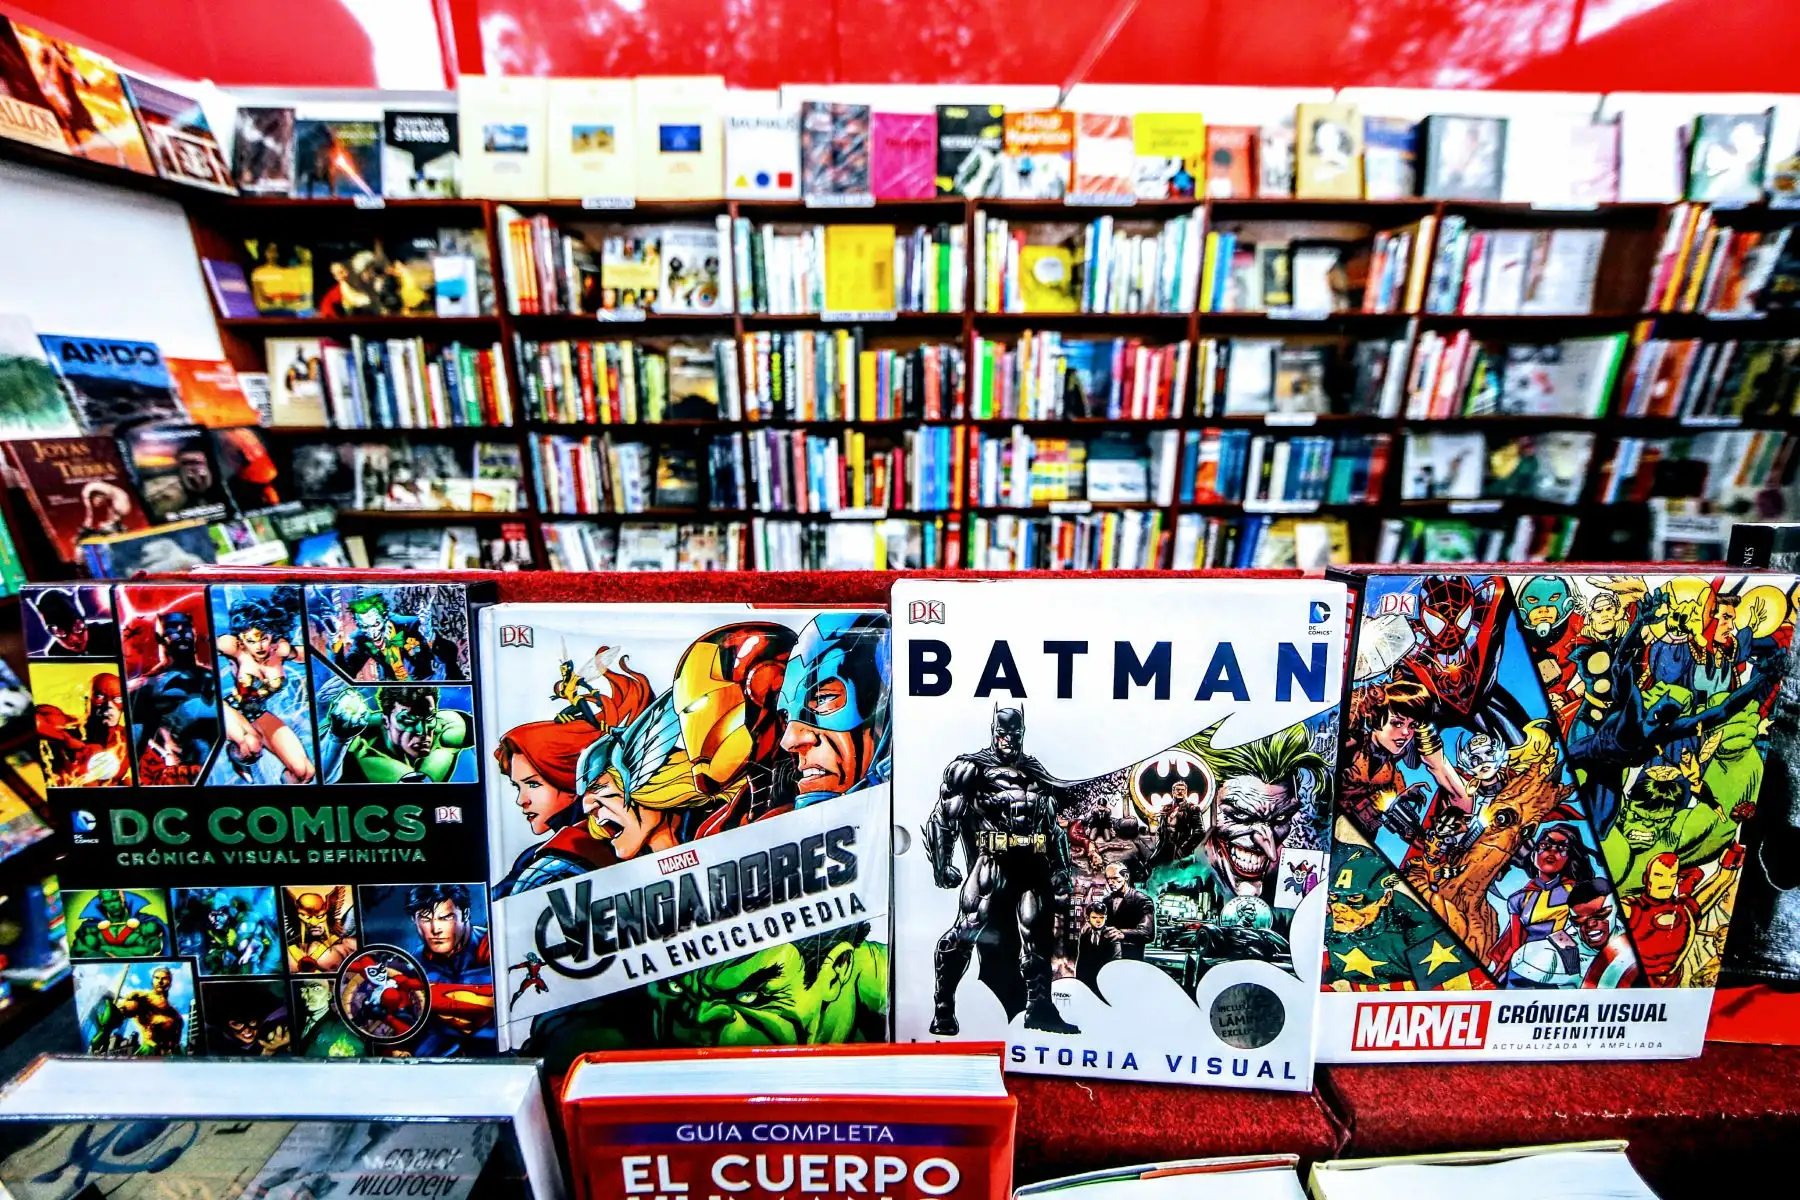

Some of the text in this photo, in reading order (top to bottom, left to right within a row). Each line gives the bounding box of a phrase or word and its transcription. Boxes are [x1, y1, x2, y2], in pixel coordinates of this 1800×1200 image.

[62, 342, 160, 367] ANDO
[911, 601, 942, 621] DK
[1383, 595, 1413, 613] DK
[502, 626, 531, 645] DK
[908, 639, 1329, 702] BATMAN
[109, 804, 426, 845] DC COMICS
[437, 806, 460, 821] DK
[116, 849, 427, 867] CRÓNICA VISUAL DEFINITIVA
[659, 851, 698, 874] MARVEL
[536, 825, 857, 979] VENGADORES
[622, 892, 868, 980] LA ENCICLOPEDIA
[1497, 1000, 1668, 1024] CRÓNICA VISUAL
[1356, 1004, 1484, 1049] MARVEL
[1532, 1026, 1626, 1040] DEFINITIVA
[1599, 1041, 1664, 1049] AMPLIADA
[1011, 1045, 1297, 1081] STORIA VISUAL
[676, 1122, 894, 1144] GUÍA COMPLETA
[621, 1154, 960, 1194] EL CUERPO
